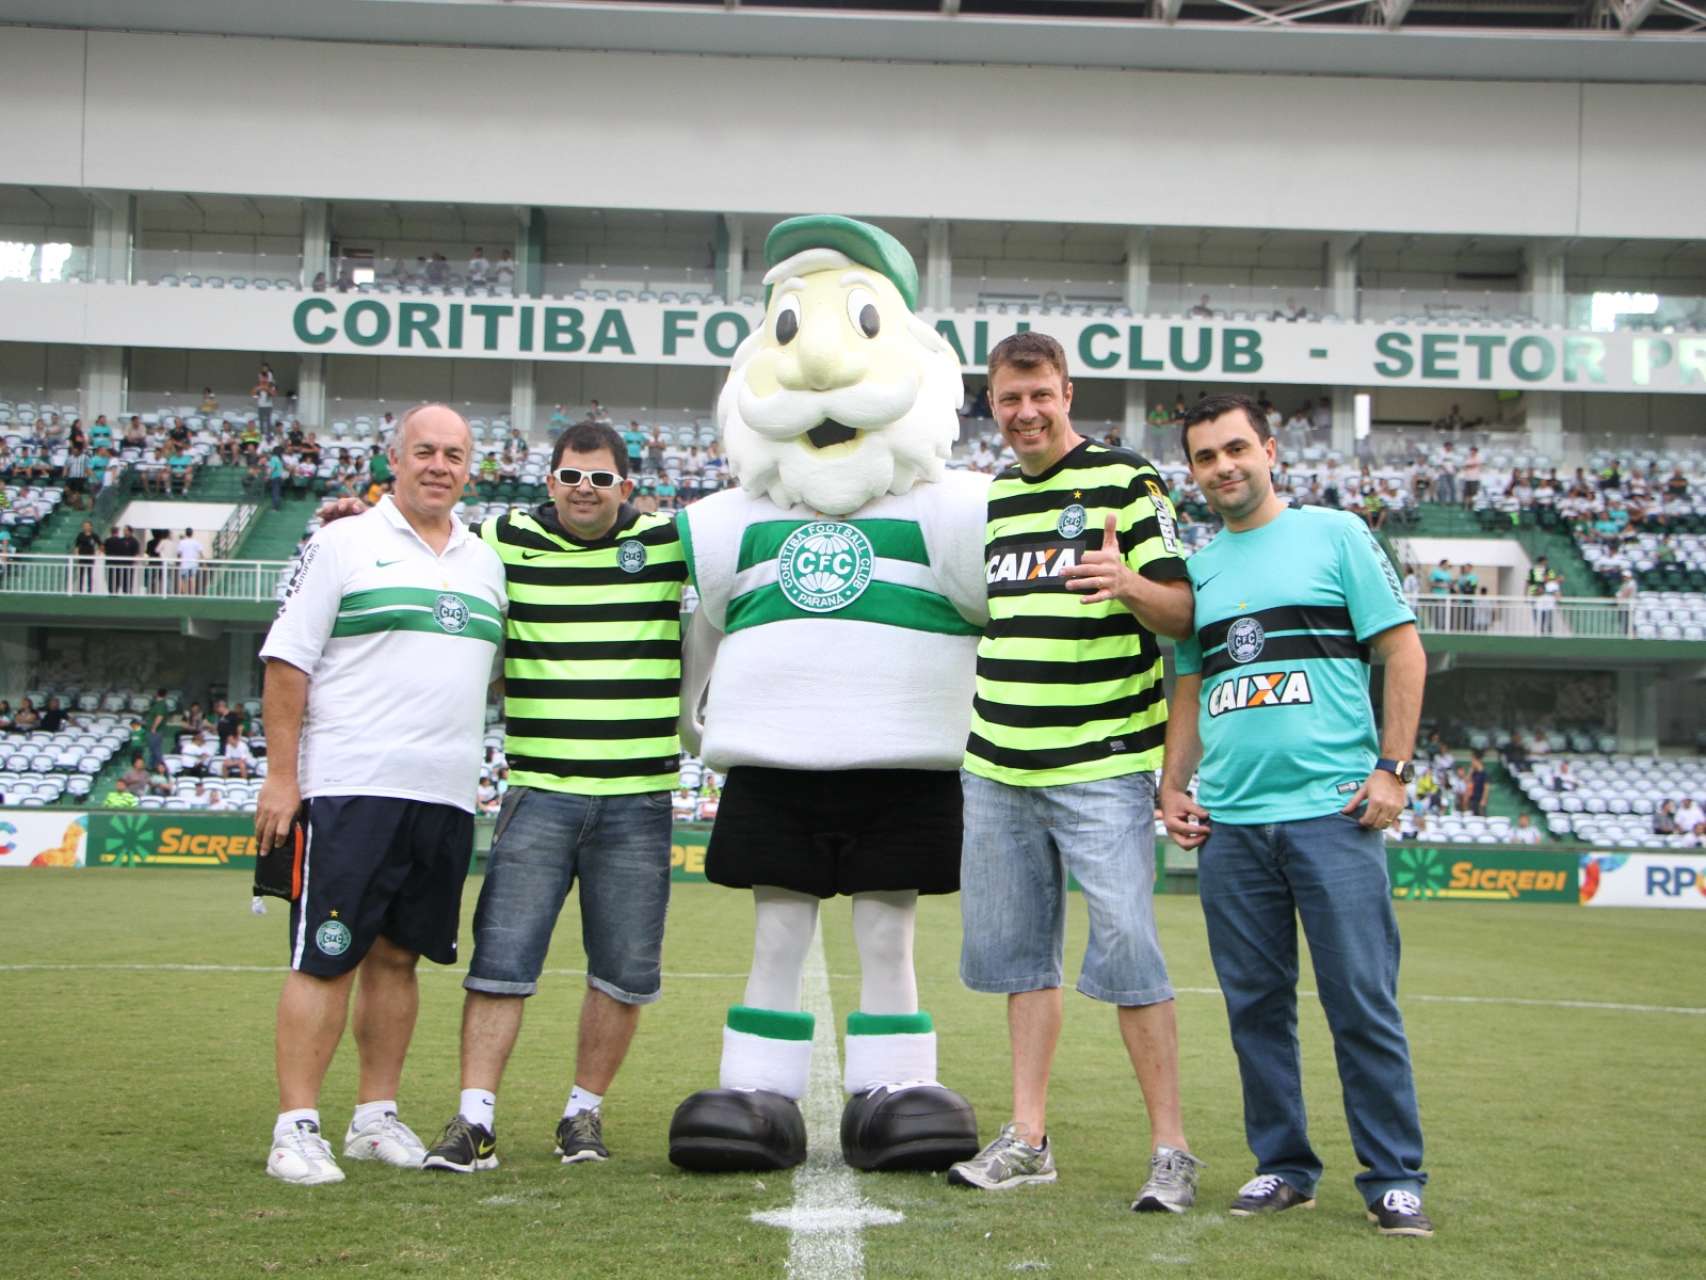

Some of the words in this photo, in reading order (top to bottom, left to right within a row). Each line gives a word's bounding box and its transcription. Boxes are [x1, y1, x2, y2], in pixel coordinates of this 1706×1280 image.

[293, 298, 635, 355] CORITIBA
[1078, 323, 1263, 373] CLUB
[1374, 332, 1606, 382] SETOR
[797, 552, 853, 575] CFC
[987, 548, 1076, 584] CAIXA
[1235, 632, 1256, 648] CFC
[1208, 671, 1313, 718] CAIXA
[158, 827, 257, 864] SICRE
[1449, 862, 1567, 897] SICREDI
